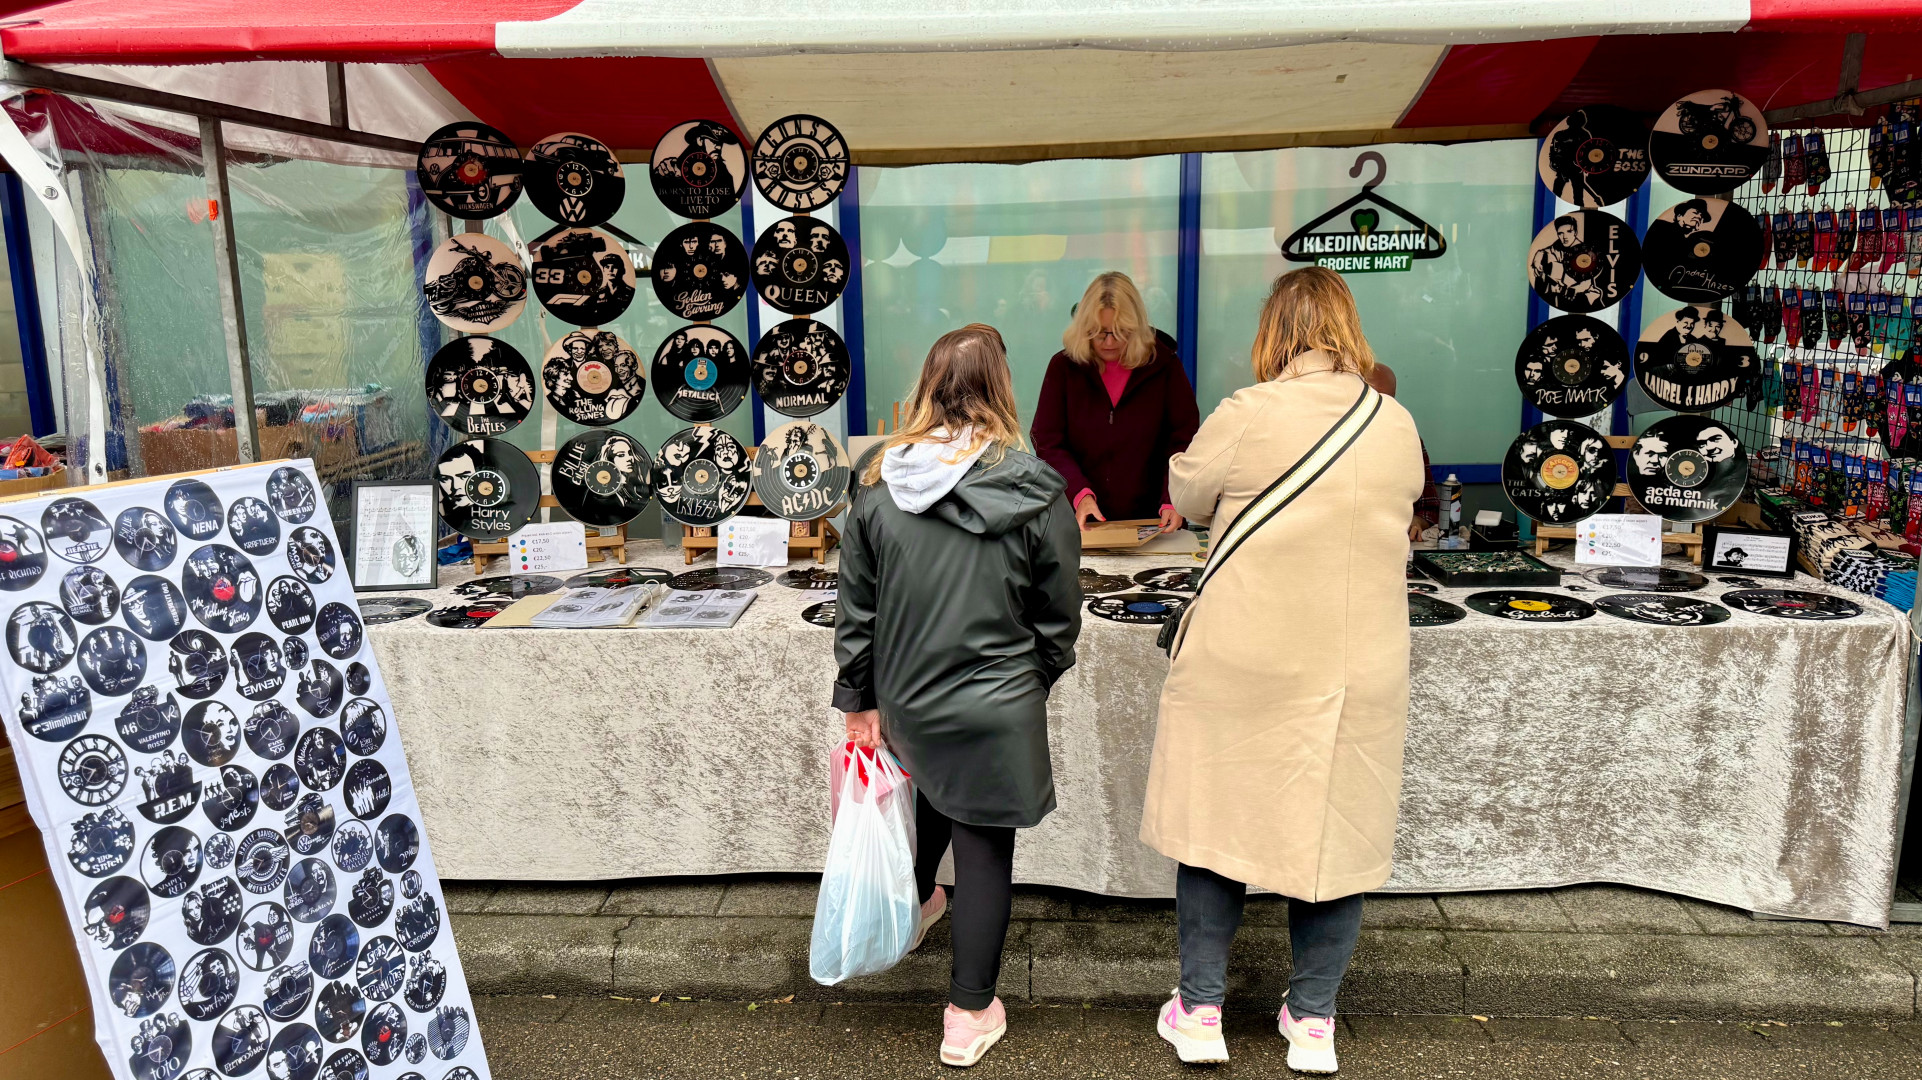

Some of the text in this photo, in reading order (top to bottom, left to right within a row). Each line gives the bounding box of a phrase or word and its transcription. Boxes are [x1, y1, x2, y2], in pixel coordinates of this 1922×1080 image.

[1618, 148, 1644, 160] THE
[1613, 161, 1646, 172] BOSS
[688, 187, 701, 195] TO
[706, 187, 731, 196] LOSE
[680, 196, 720, 205] LIVE TO
[688, 206, 710, 214] WIN
[1303, 233, 1426, 253] KLEDINGBANK
[1318, 256, 1409, 270] GROENE HART
[1607, 225, 1620, 298] ELVIS
[535, 268, 565, 284] 33
[674, 289, 712, 309] Golden
[764, 284, 829, 307] QUEEN
[683, 301, 724, 318] Earring
[1639, 352, 1750, 367] 9 3
[1644, 372, 1739, 406] LAUREL & HARDY
[574, 399, 592, 407] THE
[668, 385, 726, 415] METALLICA
[776, 393, 828, 408] NORMAAL
[569, 404, 604, 415] ROLLING
[576, 412, 604, 421] STONES
[467, 416, 507, 436] BEATLES
[559, 441, 586, 478] BILLIE
[1507, 479, 1525, 487] THE
[1511, 488, 1541, 498] CATS
[1646, 485, 1702, 499] acda en
[676, 496, 719, 519] KISS
[1645, 496, 1718, 510] de munnik
[279, 505, 315, 518] GREEN DAY
[471, 507, 510, 520] Harry
[192, 520, 219, 535] NENA
[471, 518, 511, 532] Styles
[66, 542, 100, 554] BEASTIE
[244, 537, 278, 548] KRAFTWERK
[8, 566, 42, 579] RICHARD
[228, 611, 251, 627] Stones
[281, 615, 312, 630] PEARL JAM
[243, 676, 282, 697] EMINEM
[121, 722, 138, 736] 46
[138, 729, 171, 744] VALENTINO
[147, 740, 166, 750] ROSSI
[153, 792, 195, 820] R.E.M.
[342, 849, 370, 867] SPANDAU
[346, 857, 368, 871] BALLET
[158, 877, 182, 892] SIMPLY
[168, 882, 187, 895] RED
[275, 924, 289, 937] JAMES
[405, 926, 438, 949] FOREIGNER
